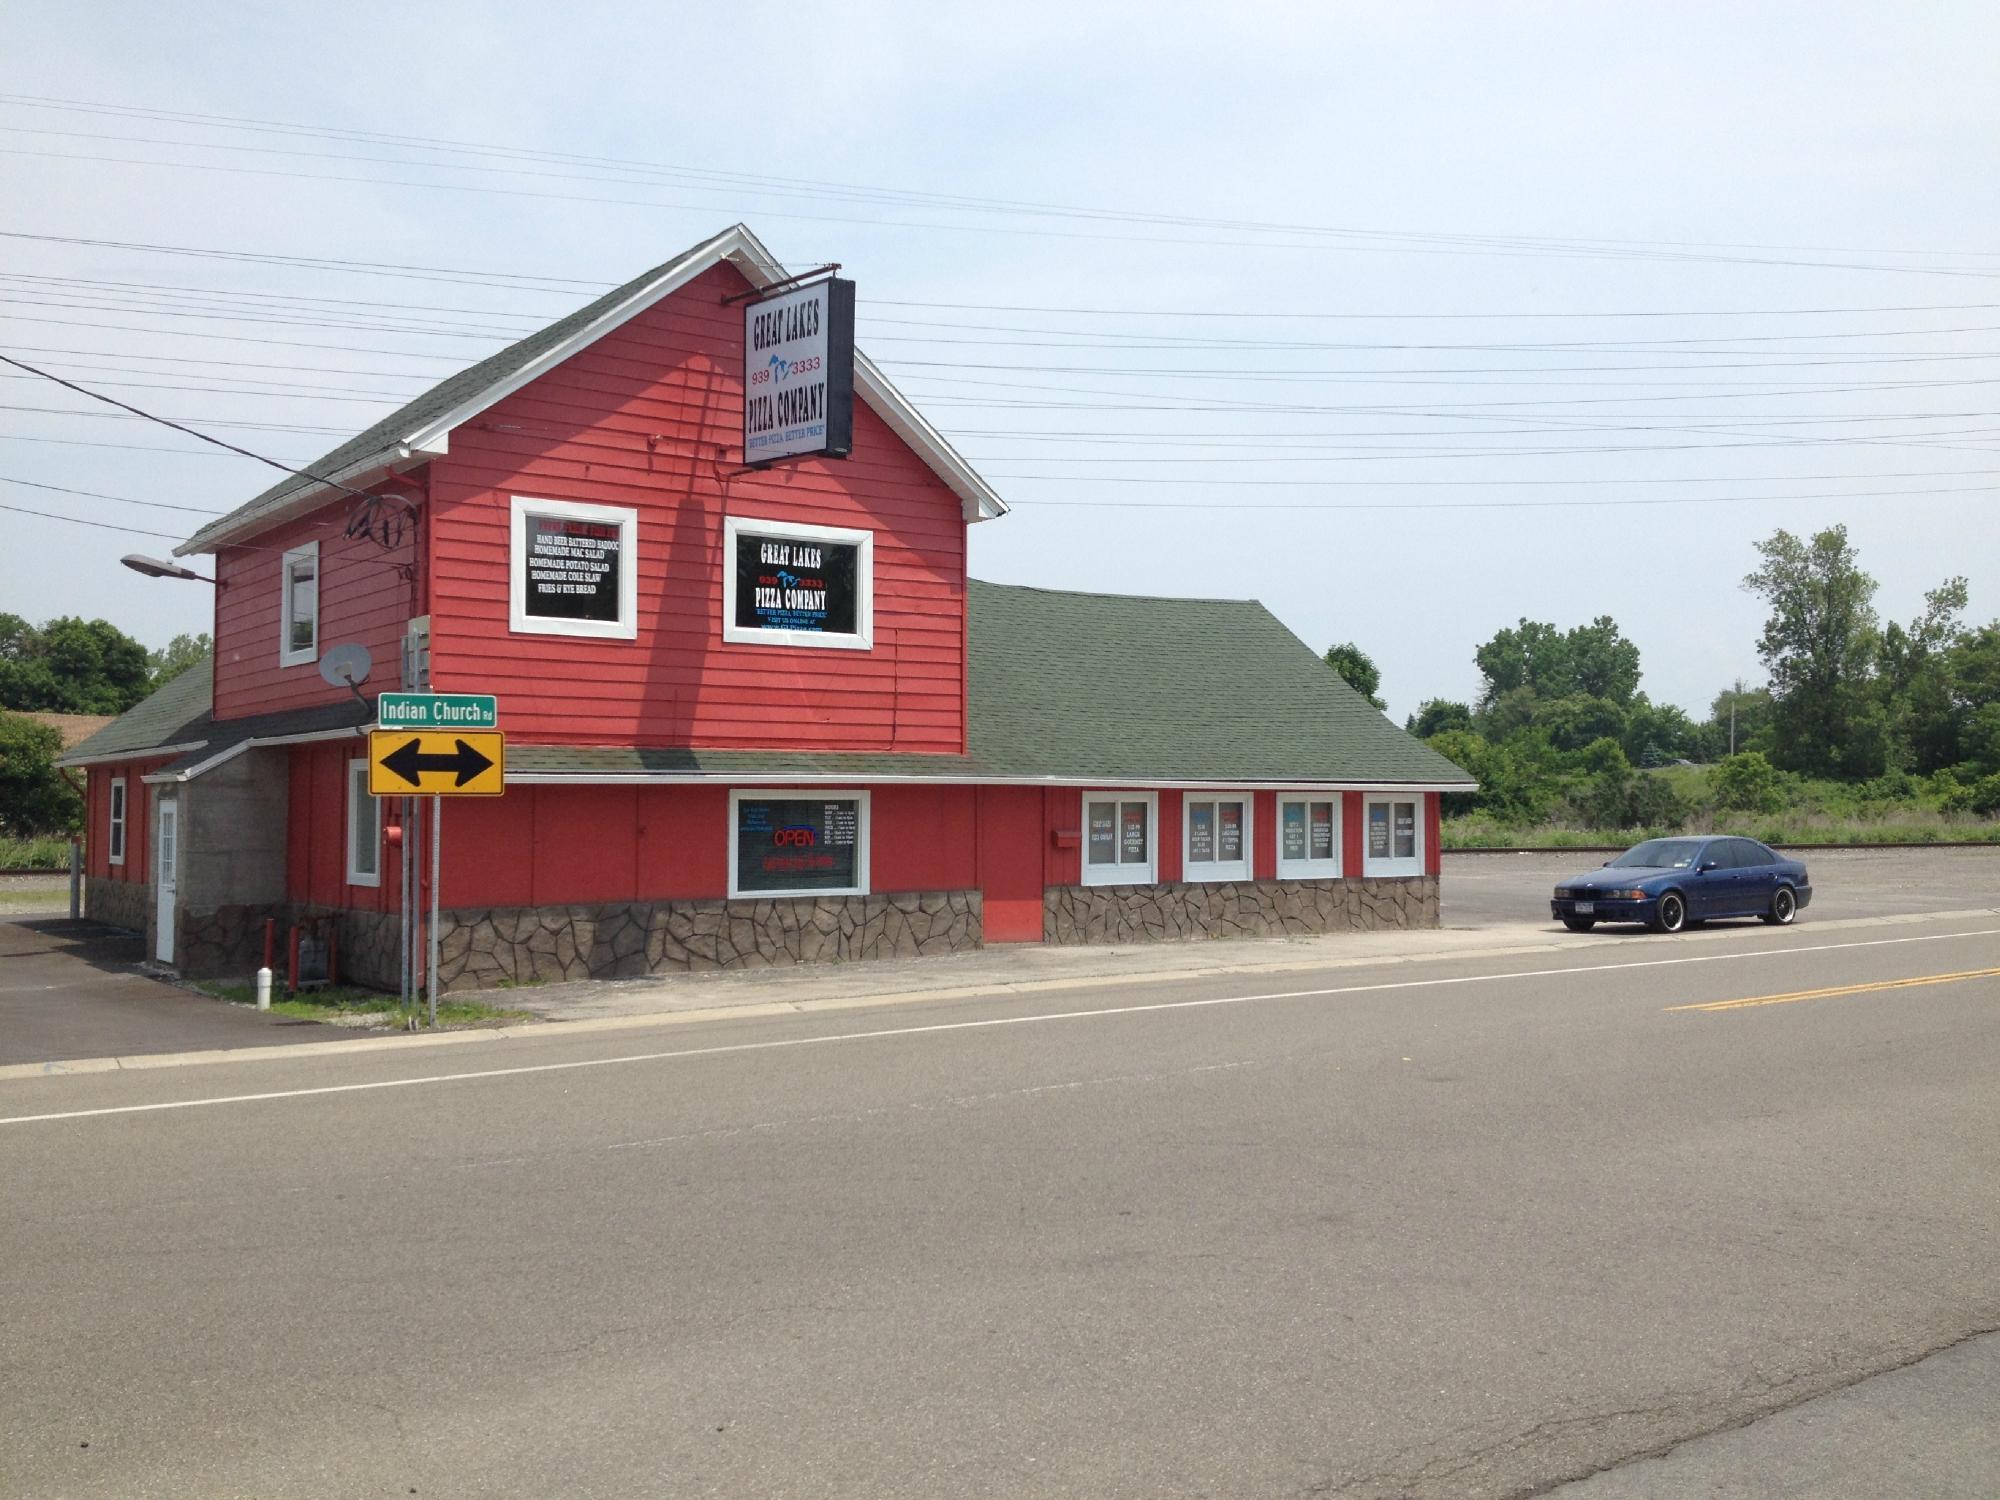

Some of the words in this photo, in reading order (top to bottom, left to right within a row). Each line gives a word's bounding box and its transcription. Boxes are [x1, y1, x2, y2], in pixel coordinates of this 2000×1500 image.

[753, 309, 783, 352] GREAT
[785, 298, 819, 342] LAKES
[752, 369, 770, 385] 939
[791, 356, 821, 375] 3333
[748, 394, 774, 434] PIZZA
[777, 382, 825, 427] COMPANY
[536, 535, 553, 545] HAND
[553, 536, 568, 546] BEER
[568, 537, 597, 548] BATTERED
[535, 545, 570, 556] HOMEMADE
[570, 548, 585, 558] MAC
[585, 549, 605, 559] SALAD
[760, 543, 790, 566] GREAT
[793, 546, 822, 569] LAKES
[529, 557, 565, 569] HOMEMADE
[565, 560, 590, 571] POTATO
[590, 562, 610, 572] SALAD
[531, 570, 567, 581] HOMEMADE
[568, 571, 584, 582] COLE
[584, 573, 602, 582] SLAW
[538, 583, 556, 593] FRIES
[562, 584, 575, 594] RYE
[575, 585, 597, 594] BREAD
[755, 587, 782, 608] PIZZA
[785, 590, 826, 611] COMPANY
[383, 700, 426, 719] Indian
[433, 701, 481, 721] Church
[482, 710, 493, 721] Rd
[774, 830, 815, 847] OPEN
